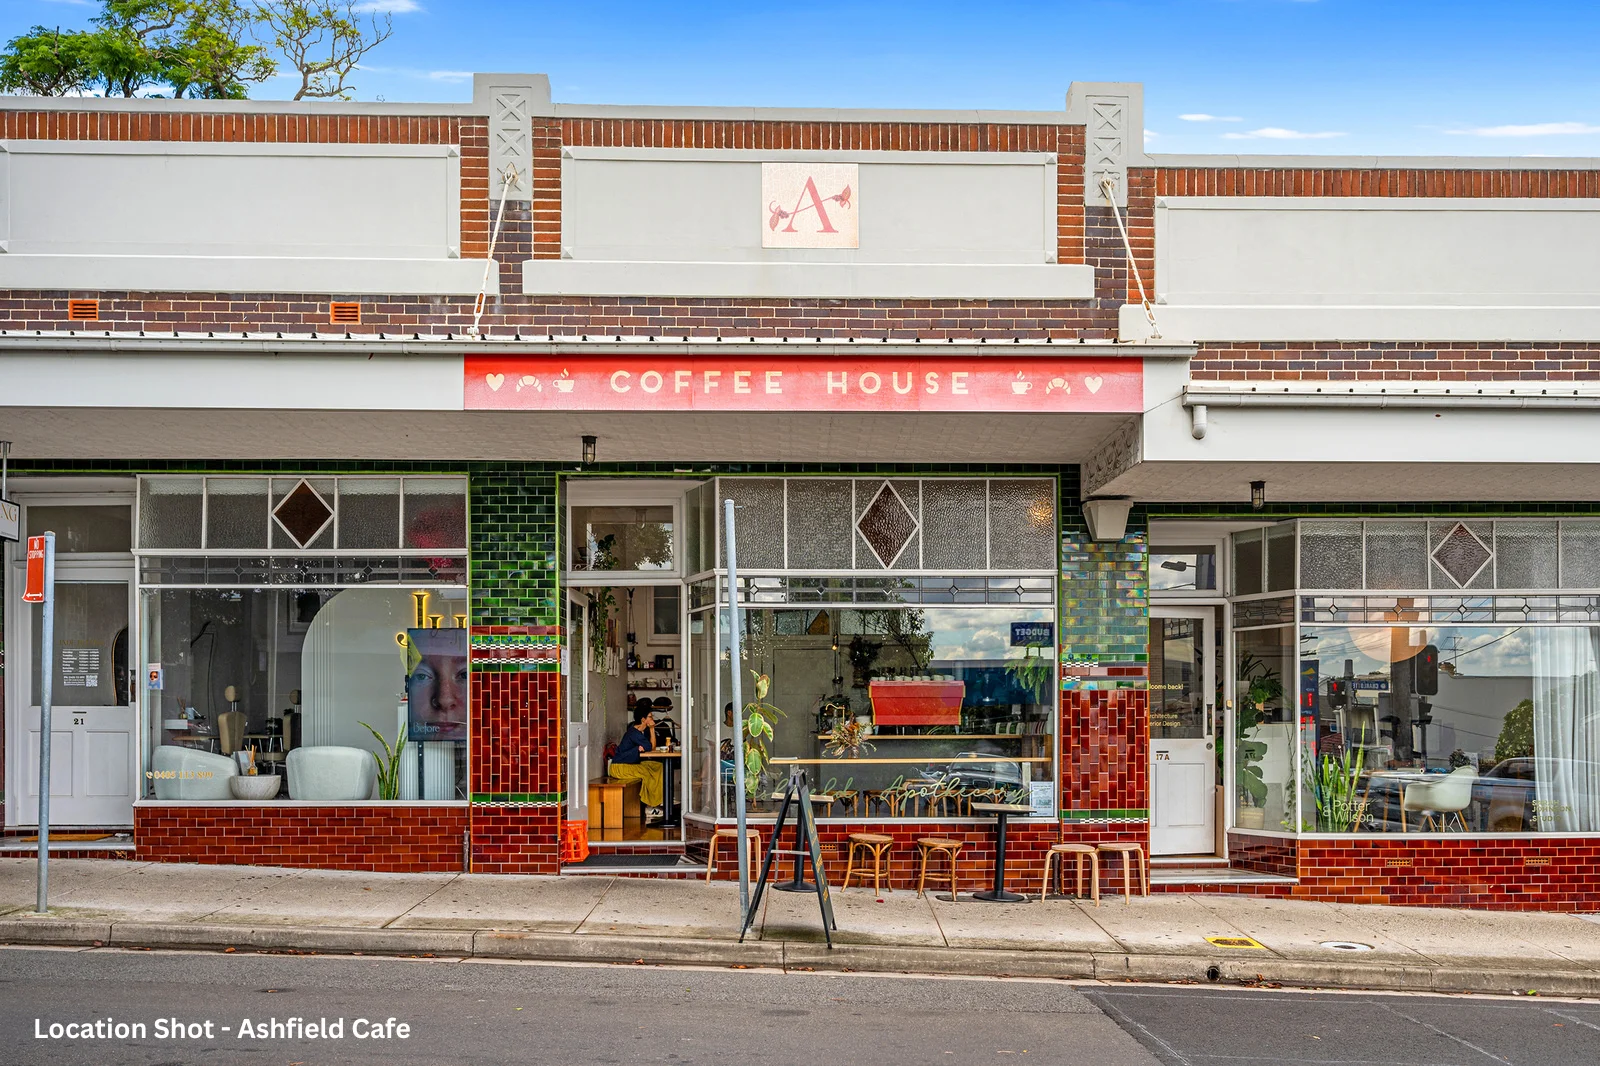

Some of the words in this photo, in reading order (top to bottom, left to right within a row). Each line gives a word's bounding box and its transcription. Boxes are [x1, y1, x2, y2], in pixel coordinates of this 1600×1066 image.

[610, 370, 783, 394] COFFEE
[827, 371, 969, 395] HOUSE
[73, 717, 84, 725] 21
[413, 721, 440, 735] Before
[880, 773, 1034, 812] Apothecary
[1333, 800, 1371, 812] Potter
[1333, 811, 1374, 822] Wilson
